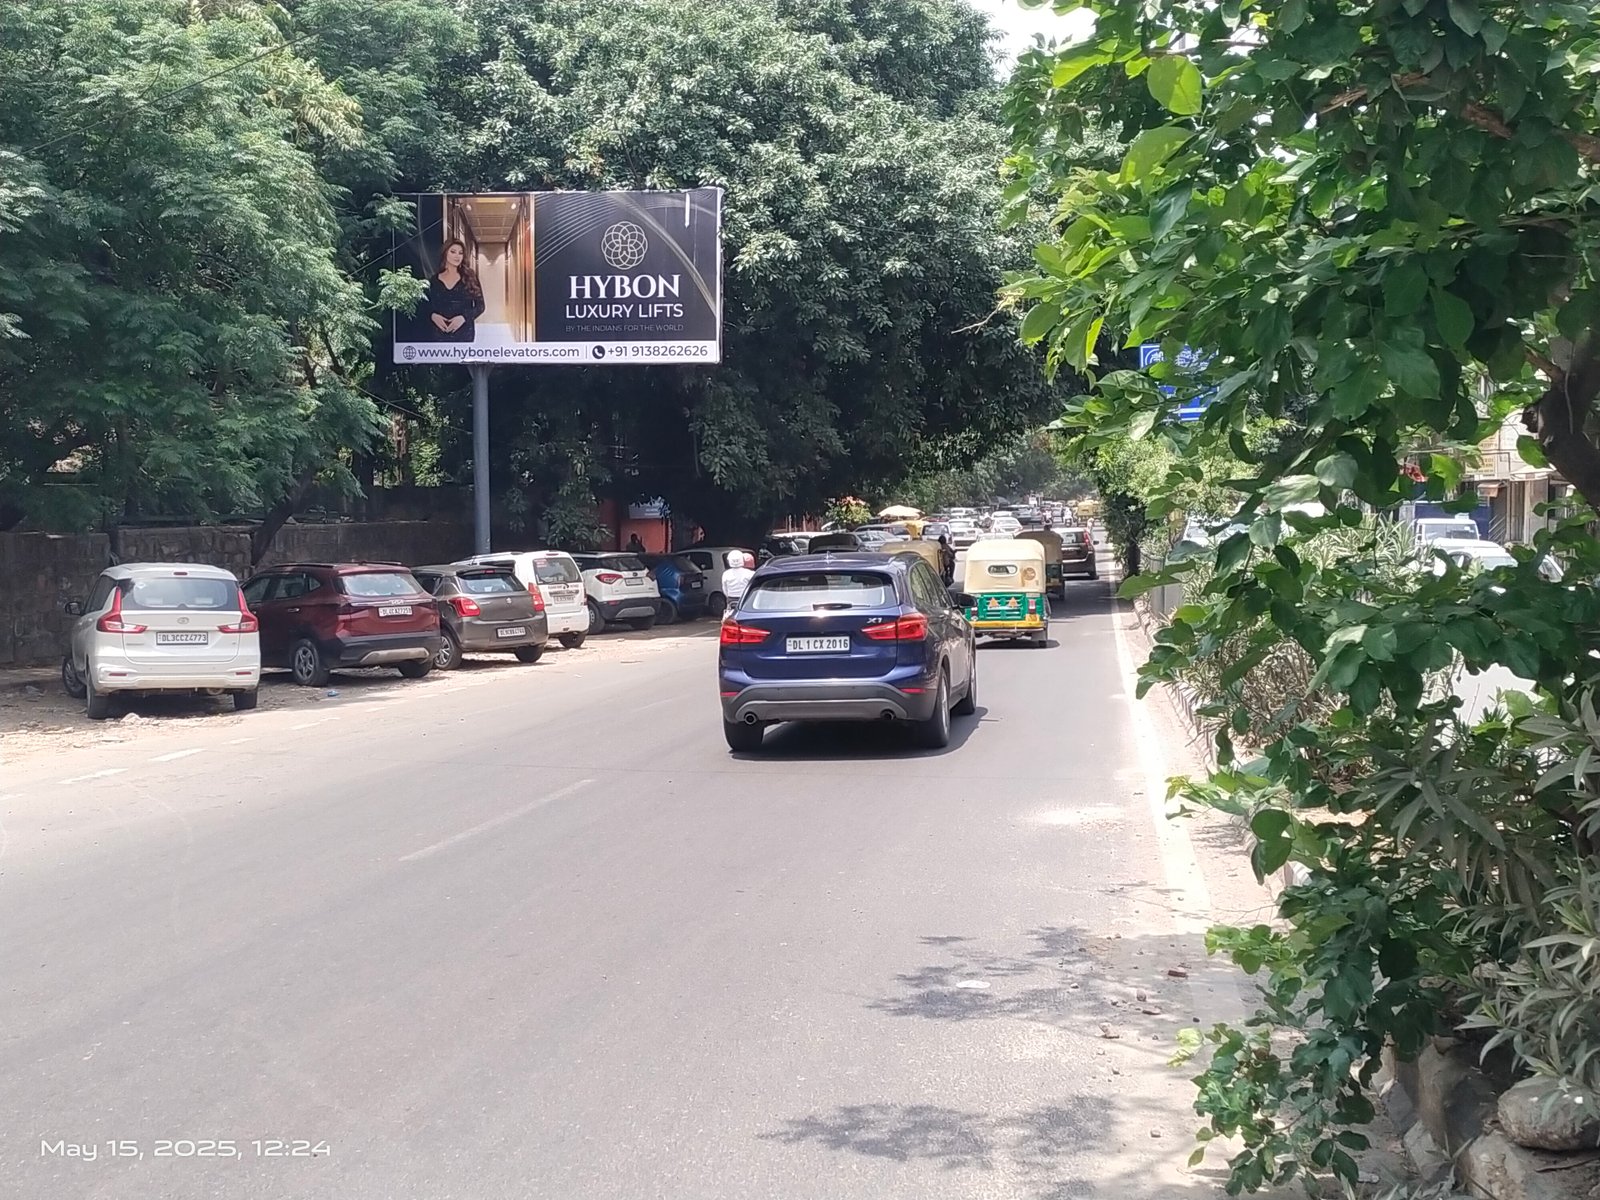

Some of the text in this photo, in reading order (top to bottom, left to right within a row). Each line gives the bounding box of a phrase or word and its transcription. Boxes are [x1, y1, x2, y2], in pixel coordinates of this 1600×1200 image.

[569, 274, 681, 299] HYBON
[566, 303, 684, 318] LUXURY LIFTS
[624, 324, 639, 332] FOR
[418, 345, 708, 360] www.hybonelevators.com +91 9138262626
[162, 634, 207, 642] DL3CCZ4773
[792, 640, 804, 650] DL
[813, 639, 824, 649] CX
[826, 638, 849, 649] 2016
